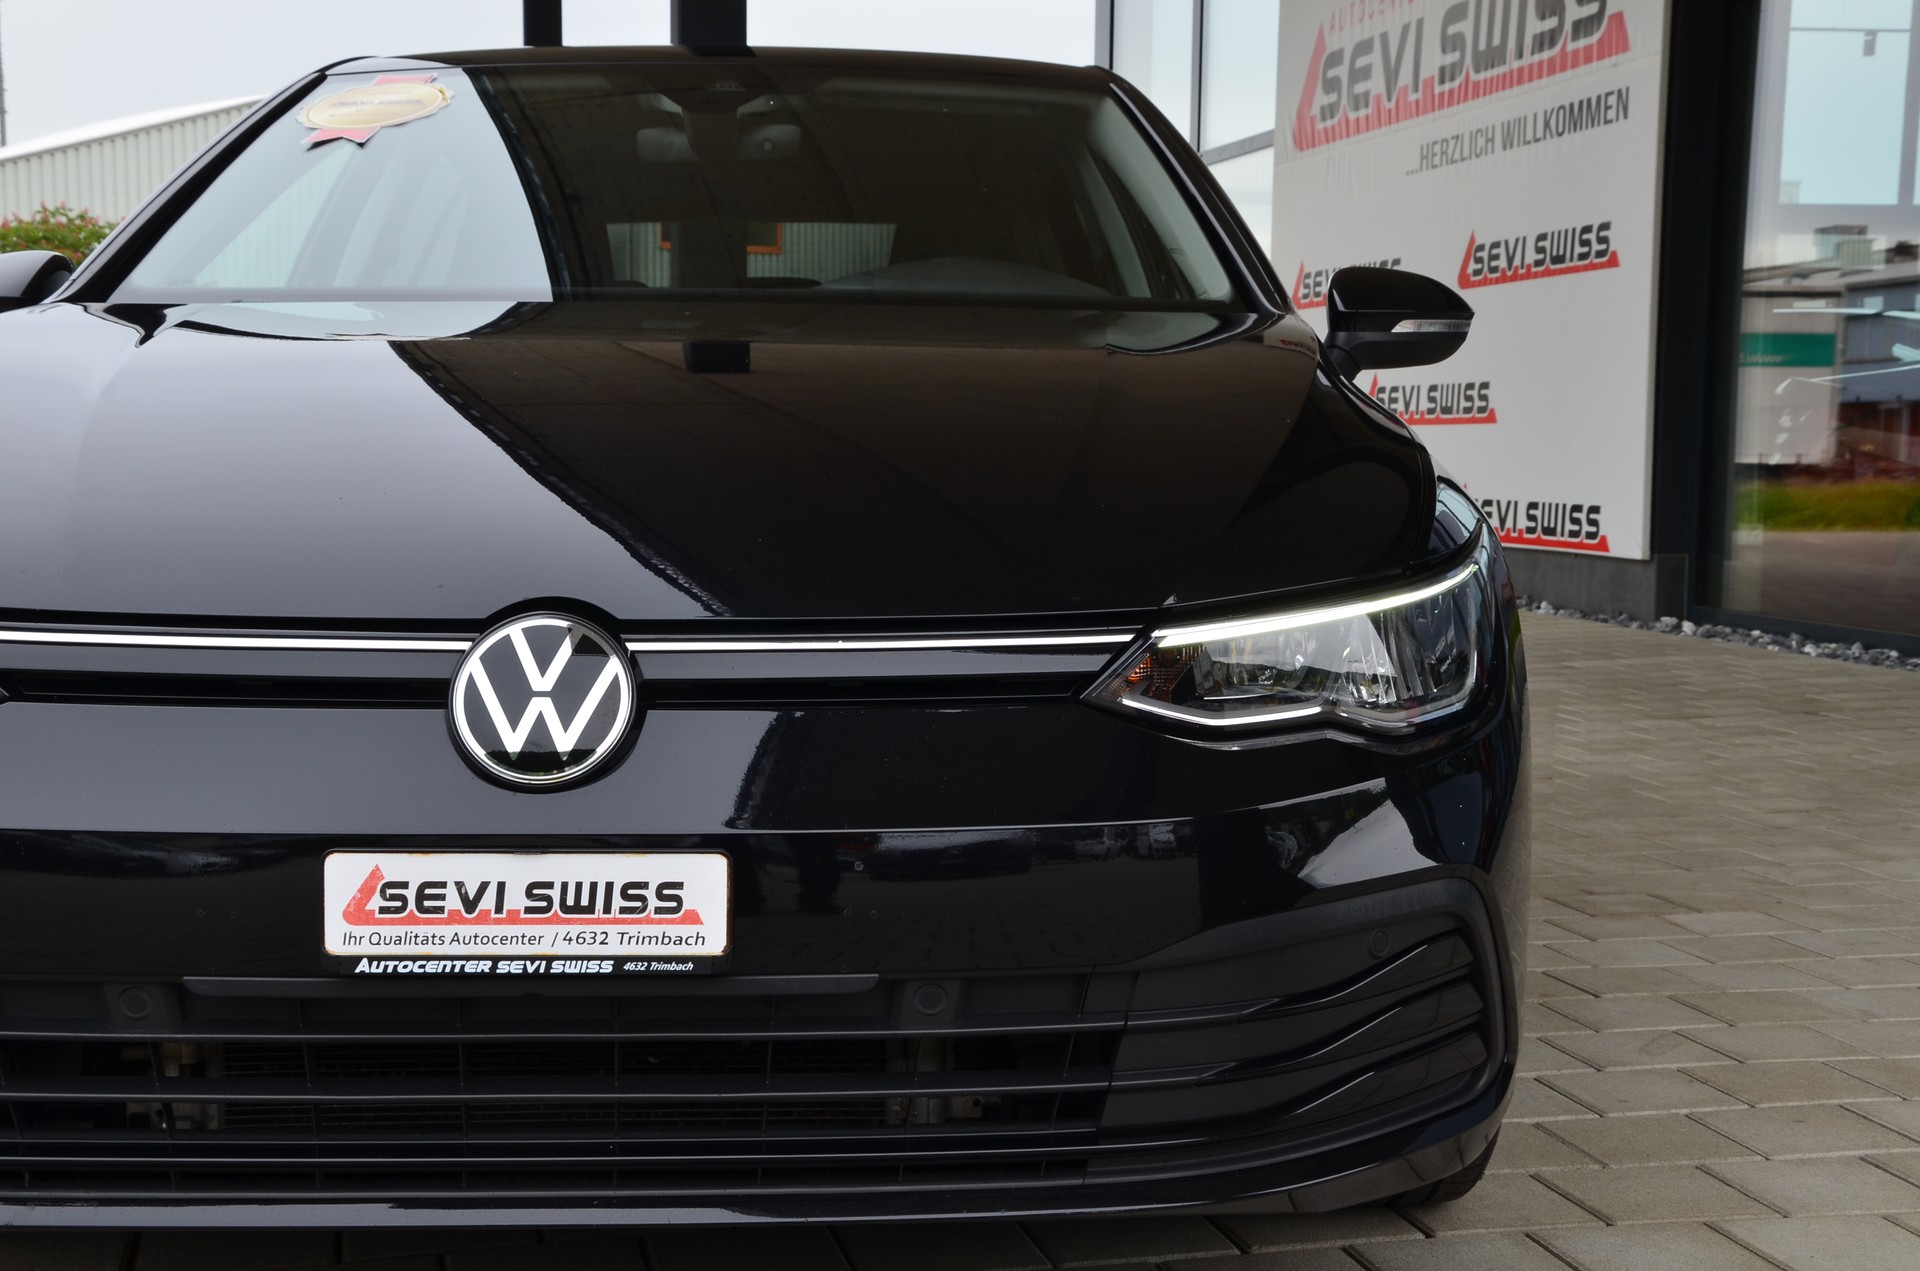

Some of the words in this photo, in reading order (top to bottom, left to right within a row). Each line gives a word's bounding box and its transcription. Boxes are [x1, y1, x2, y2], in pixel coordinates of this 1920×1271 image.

[1319, 16, 1424, 123] SEVI
[1501, 86, 1630, 151] WILLKOMMEN
[1472, 236, 1527, 277] SEVI
[1533, 221, 1611, 268] SWISS
[1376, 385, 1421, 416] SEVI
[1427, 381, 1490, 416] SWISS
[1475, 499, 1518, 533] EVI
[1525, 501, 1601, 541] SWISS
[460, 617, 623, 766] VW
[377, 880, 507, 916] SEVI
[523, 880, 685, 916] SWISS
[342, 931, 365, 946] Ihr
[368, 931, 446, 947] Qualitäts
[449, 931, 544, 946] Autocenter
[562, 931, 609, 946] 4632
[616, 931, 706, 946] Trimbach
[354, 957, 492, 974] AUTOCENTER
[495, 959, 547, 974] SEVI
[550, 959, 615, 974] SWISS
[622, 961, 648, 971] 4632
[649, 961, 694, 972] Trimbach
